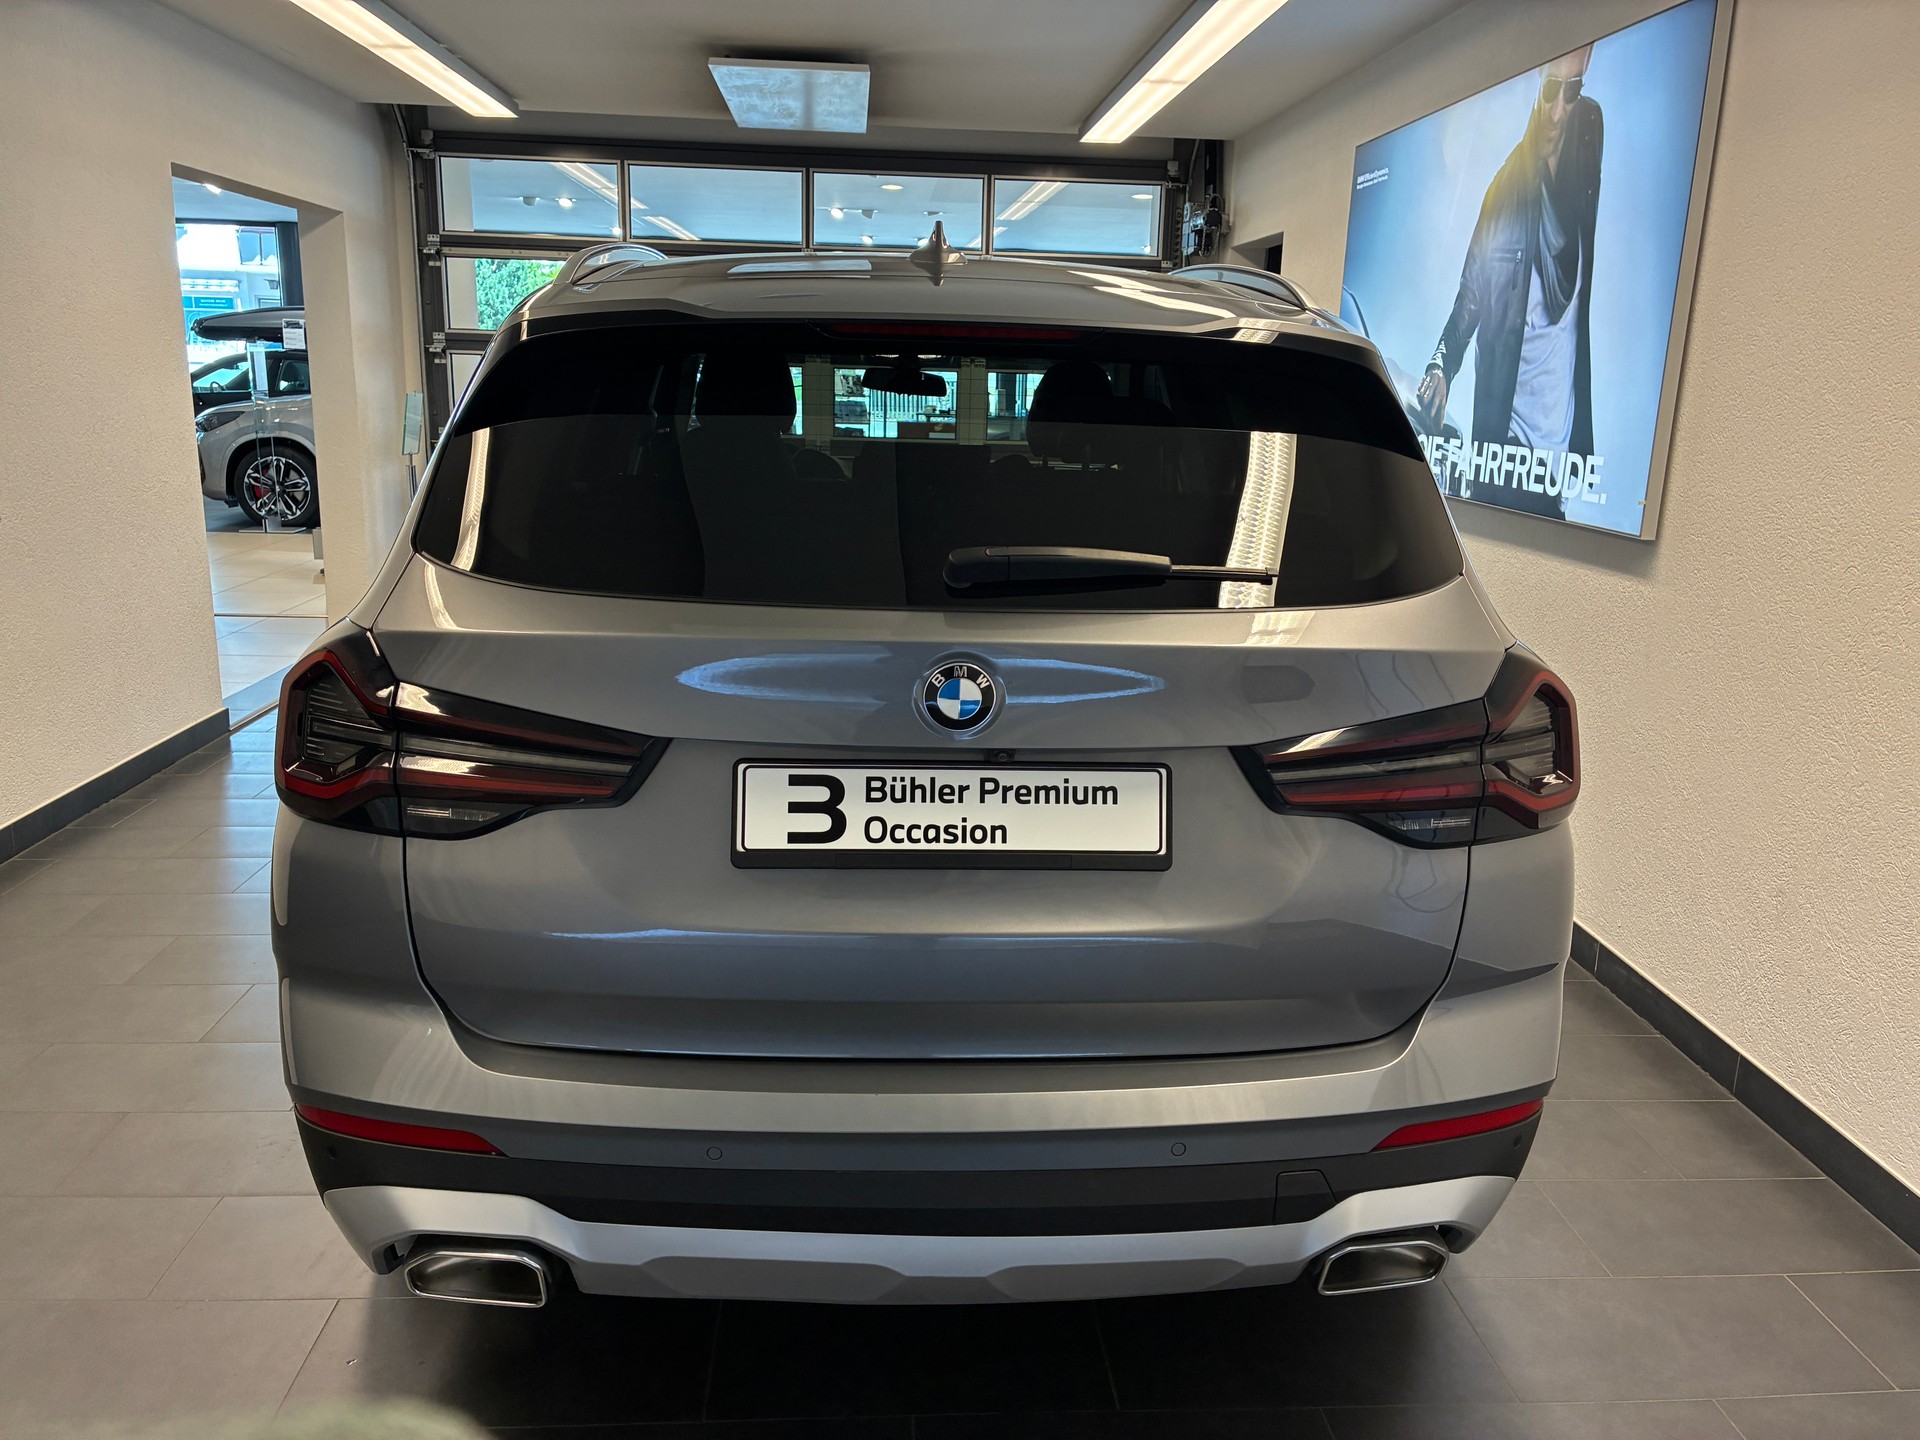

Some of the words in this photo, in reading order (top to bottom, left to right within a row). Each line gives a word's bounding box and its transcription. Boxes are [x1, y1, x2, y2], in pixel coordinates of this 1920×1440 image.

[1417, 434, 1445, 475] IE
[1446, 438, 1607, 504] FAHRFREUDE.
[931, 665, 991, 689] BMW
[865, 776, 971, 804] Bühler
[979, 777, 1119, 805] Premium
[864, 816, 1008, 844] Occasion
